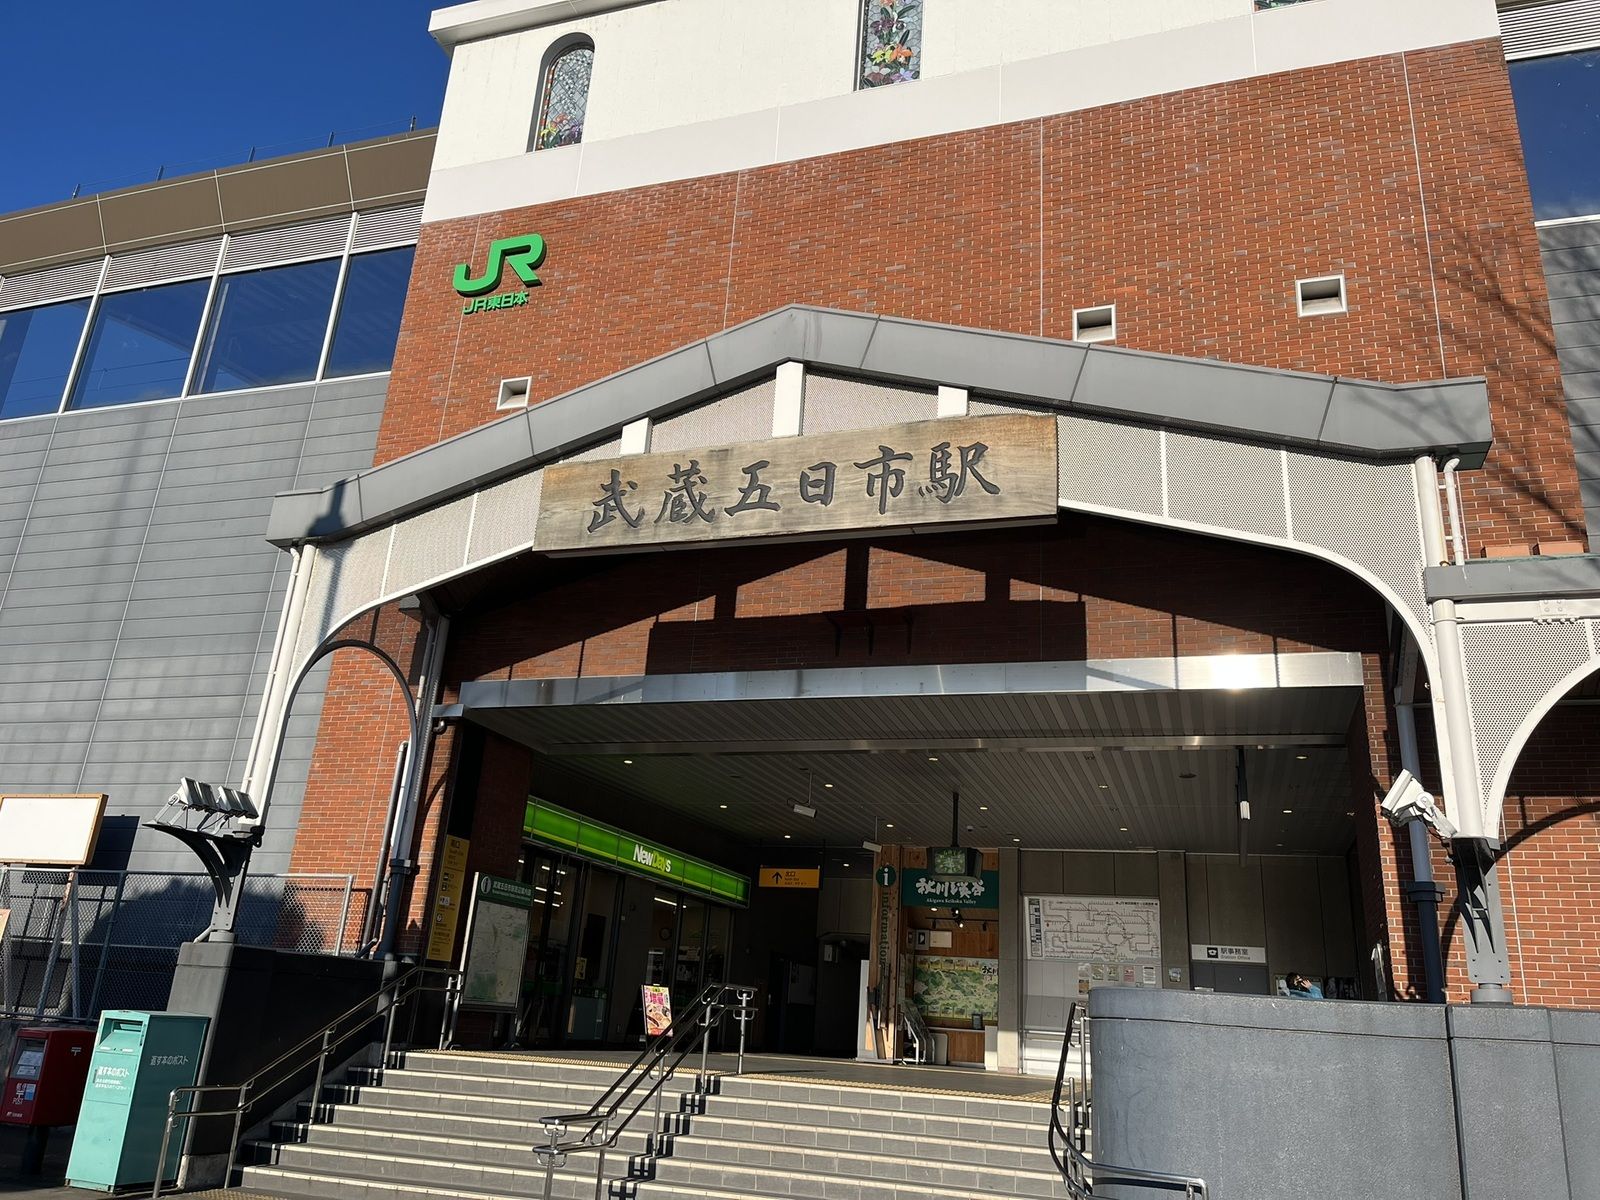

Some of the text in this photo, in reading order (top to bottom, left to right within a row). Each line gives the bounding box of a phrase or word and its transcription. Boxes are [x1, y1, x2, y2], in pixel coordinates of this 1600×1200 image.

[453, 233, 546, 296] JR
[463, 292, 529, 313] JR東日本
[587, 441, 1001, 534] 武蔵五日市駅
[633, 844, 672, 872] NewDays
[150, 1054, 189, 1066] 返す本のポスト
